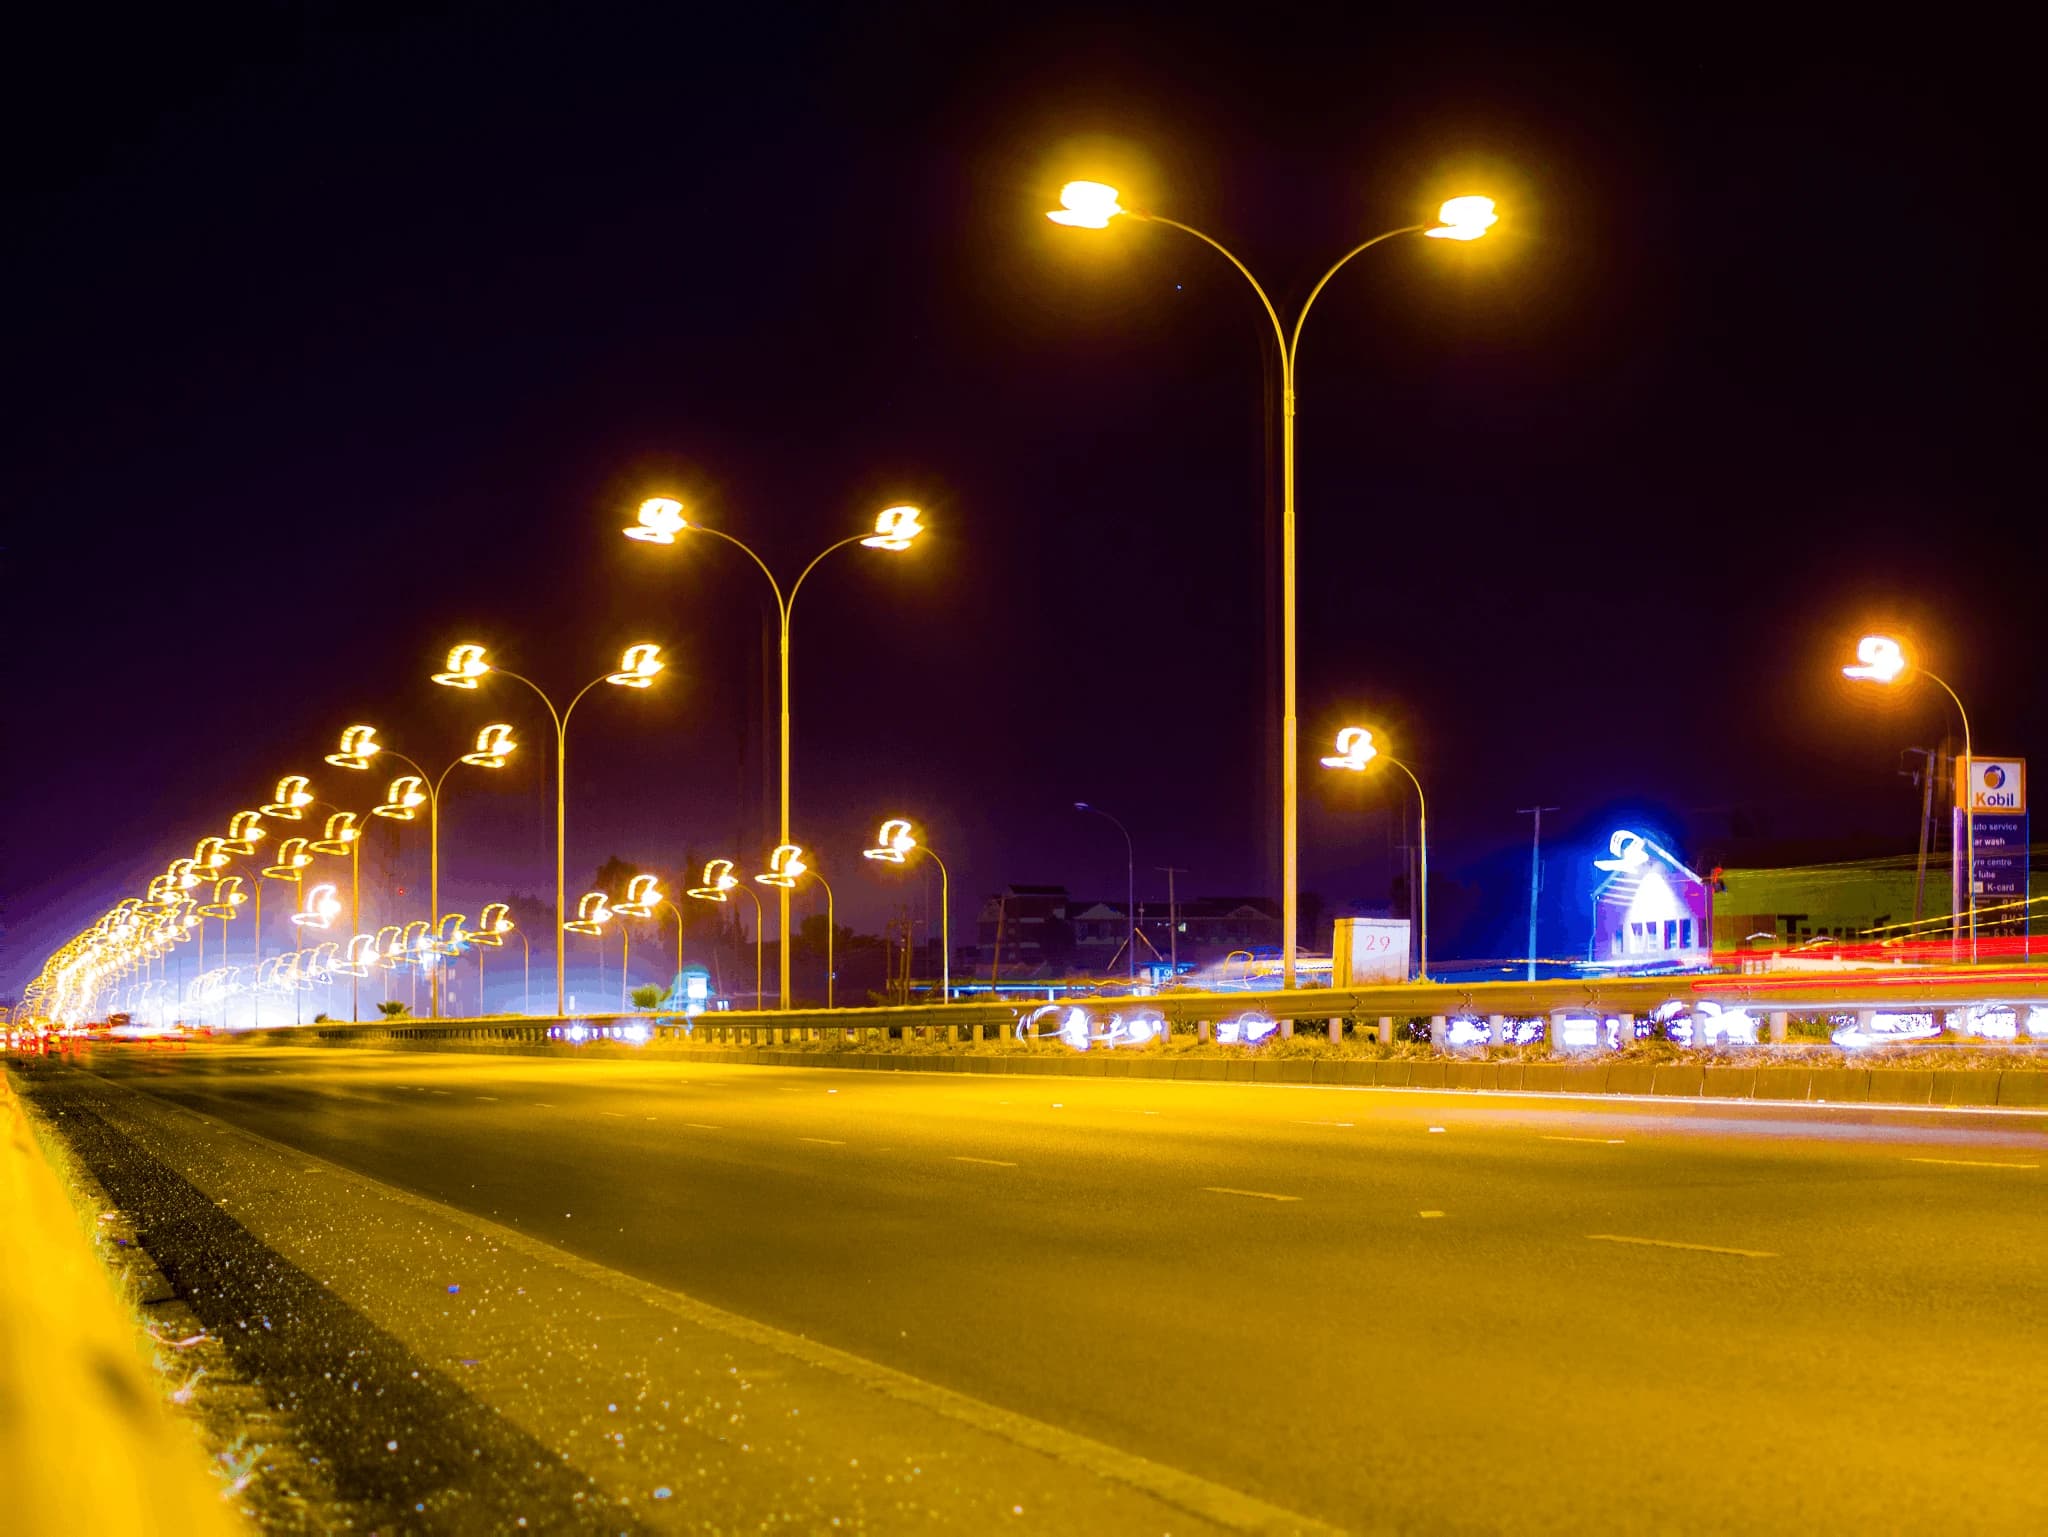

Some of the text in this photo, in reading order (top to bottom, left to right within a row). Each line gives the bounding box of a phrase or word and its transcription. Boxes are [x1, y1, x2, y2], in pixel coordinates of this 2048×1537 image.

[1976, 792, 2014, 806] Kobil
[1973, 823, 2018, 831] uto service
[1974, 838, 2006, 847] ar wash
[1973, 859, 1985, 868] yre
[1366, 934, 1391, 953] 29
